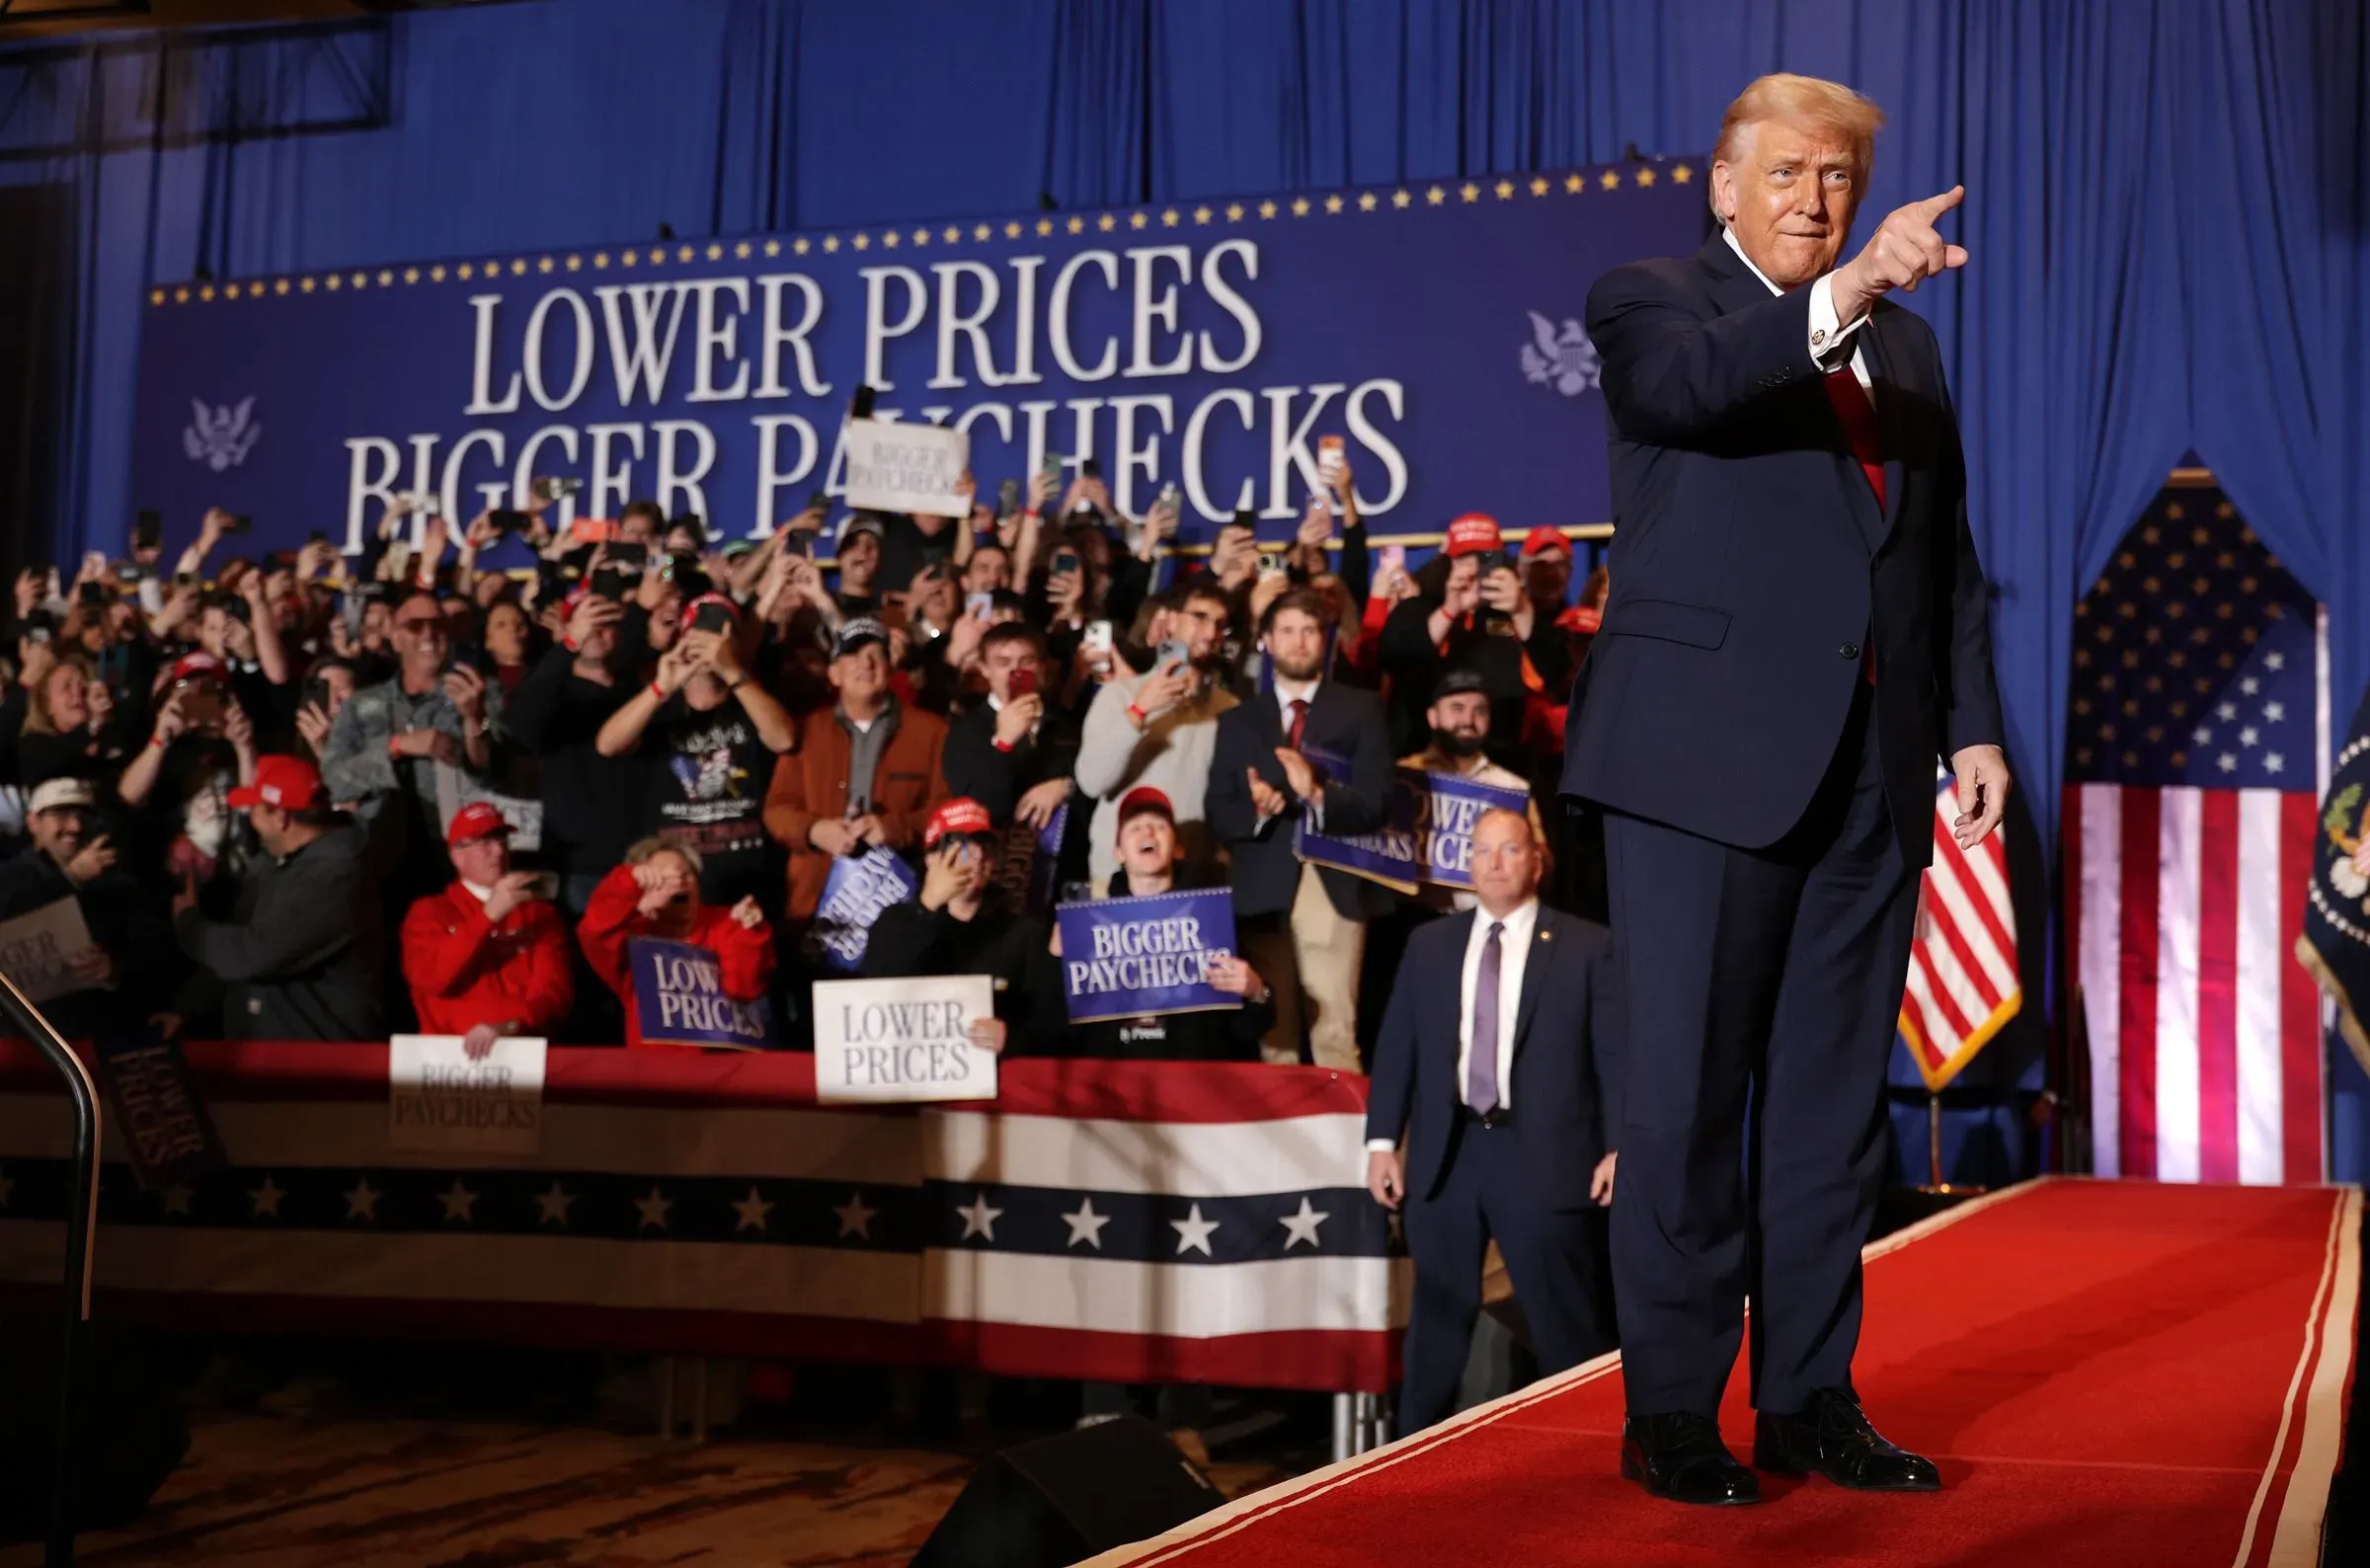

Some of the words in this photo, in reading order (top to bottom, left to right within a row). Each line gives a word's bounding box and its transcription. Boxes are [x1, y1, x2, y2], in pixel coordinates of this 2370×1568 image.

[462, 274, 832, 415] LOWER
[858, 238, 1262, 392] PRICES
[746, 379, 1408, 540] PHECKS
[848, 464, 956, 496] PAYCHECK
[1091, 916, 1204, 960] BIGGER
[653, 953, 719, 995] LOW
[842, 1000, 969, 1043] LOWER
[421, 1063, 513, 1096] BIGGER
[843, 1043, 970, 1085] PRICES
[396, 1094, 537, 1129] PAYCHECKS
